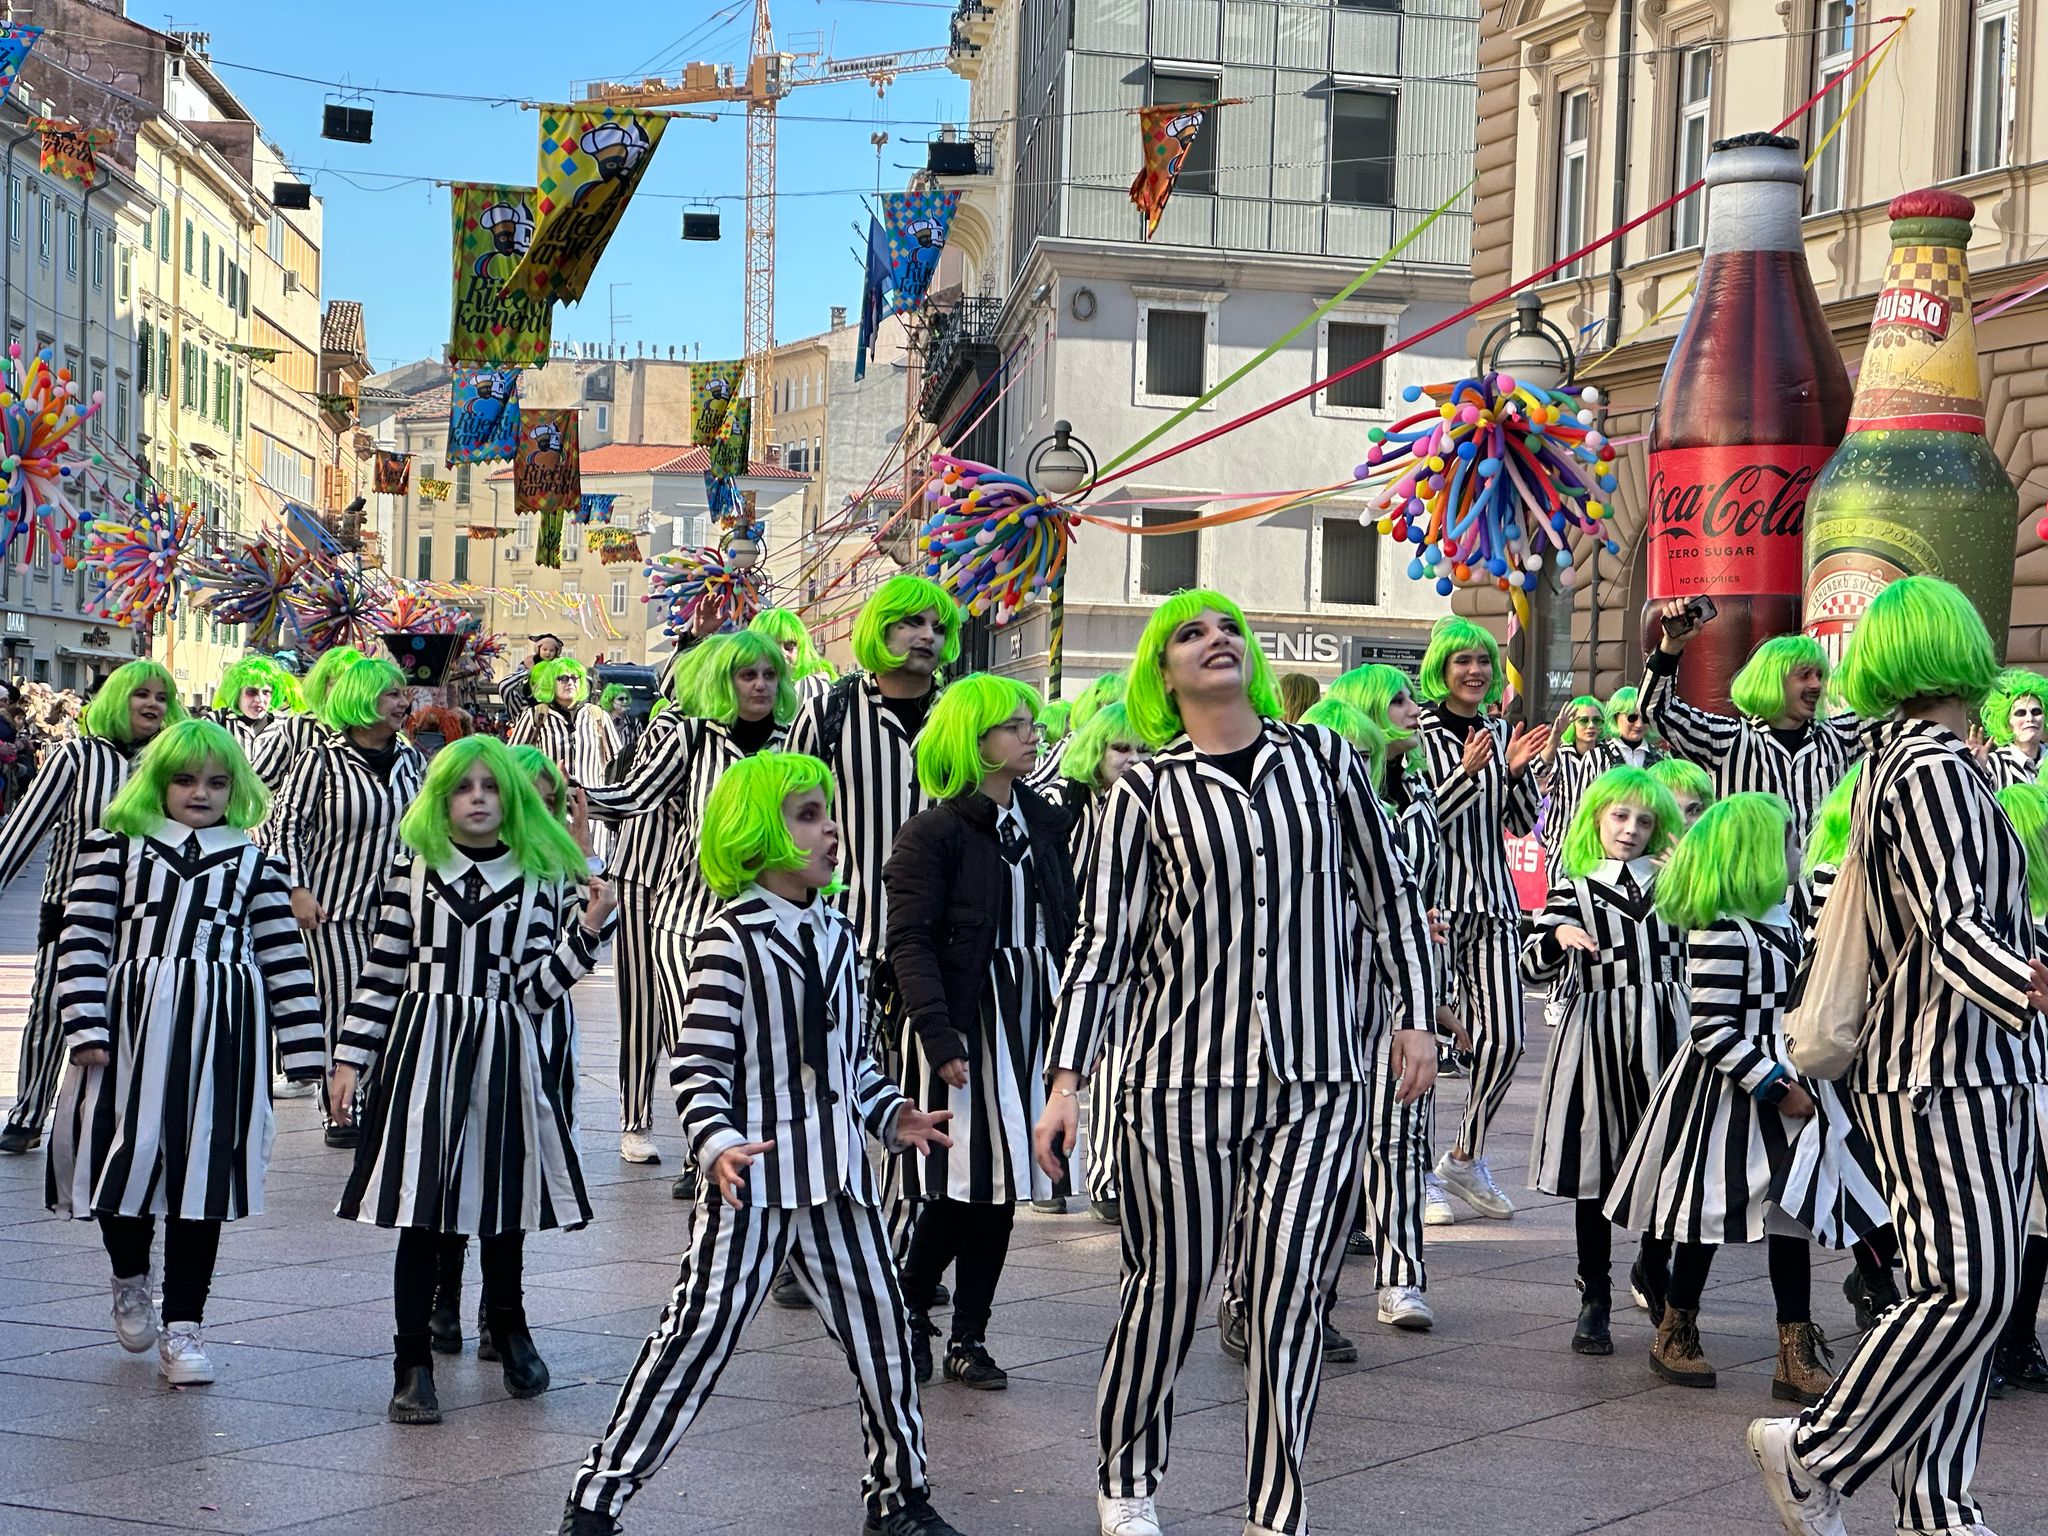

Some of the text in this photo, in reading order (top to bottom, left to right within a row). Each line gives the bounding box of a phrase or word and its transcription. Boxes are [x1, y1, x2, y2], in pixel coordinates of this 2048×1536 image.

[1668, 546, 1756, 560] ZERO SUGAR
[1679, 575, 1741, 585] NO CALORIES
[1852, 576, 1884, 596] SVIJE
